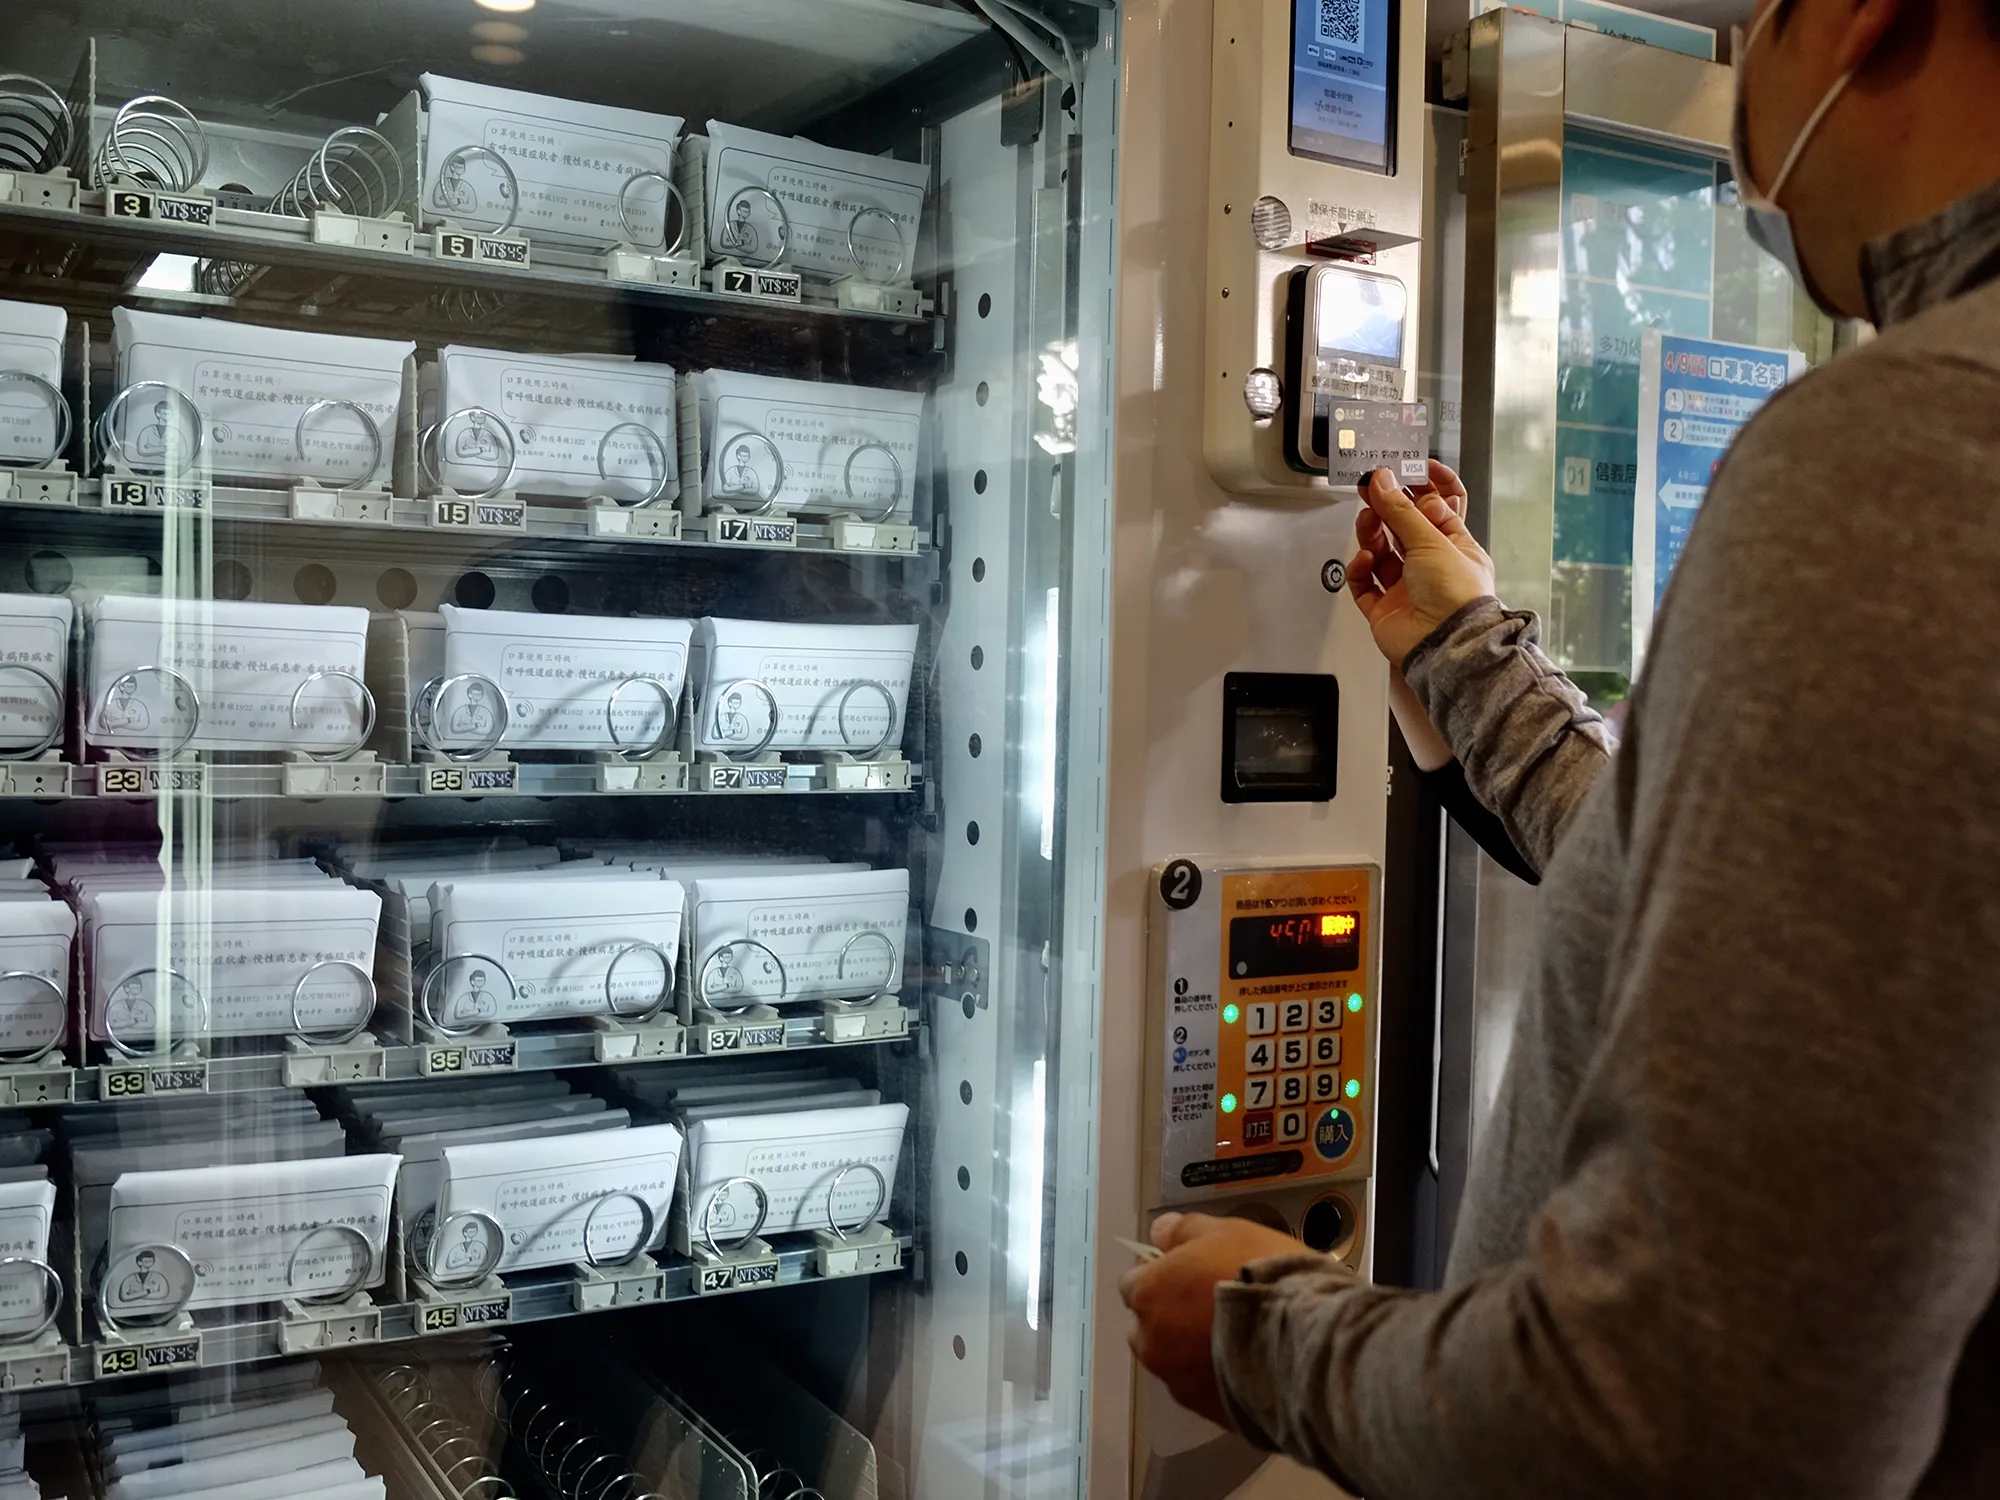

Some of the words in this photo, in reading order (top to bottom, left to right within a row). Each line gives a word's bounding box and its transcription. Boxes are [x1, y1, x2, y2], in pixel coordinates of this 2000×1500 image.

[123, 195, 142, 214] 3
[450, 236, 465, 253] 5
[732, 273, 746, 290] 7
[1405, 463, 1424, 473] VISA
[113, 483, 144, 504] 13
[439, 503, 467, 523] 15
[722, 520, 747, 539] 17
[105, 770, 141, 790] 23
[431, 769, 462, 789] 25
[713, 769, 740, 788] 27
[1169, 865, 1191, 900] 2
[1255, 1007, 1265, 1030] 1
[1286, 1004, 1303, 1027] 2
[1318, 1001, 1334, 1024] 3
[711, 1030, 738, 1049] 37
[431, 1052, 460, 1071] 35
[1251, 1044, 1268, 1067] 4
[1285, 1041, 1301, 1063] 5
[1317, 1037, 1333, 1060] 6
[110, 1073, 143, 1093] 33
[1251, 1081, 1267, 1104] 7
[1284, 1077, 1300, 1100] 8
[1316, 1073, 1332, 1096] 9
[1245, 1119, 1271, 1139] 訂正
[1283, 1113, 1300, 1136] 0
[1319, 1124, 1349, 1144] 購入
[704, 1269, 731, 1289] 47
[426, 1307, 457, 1328] 45
[102, 1350, 137, 1371] 43
